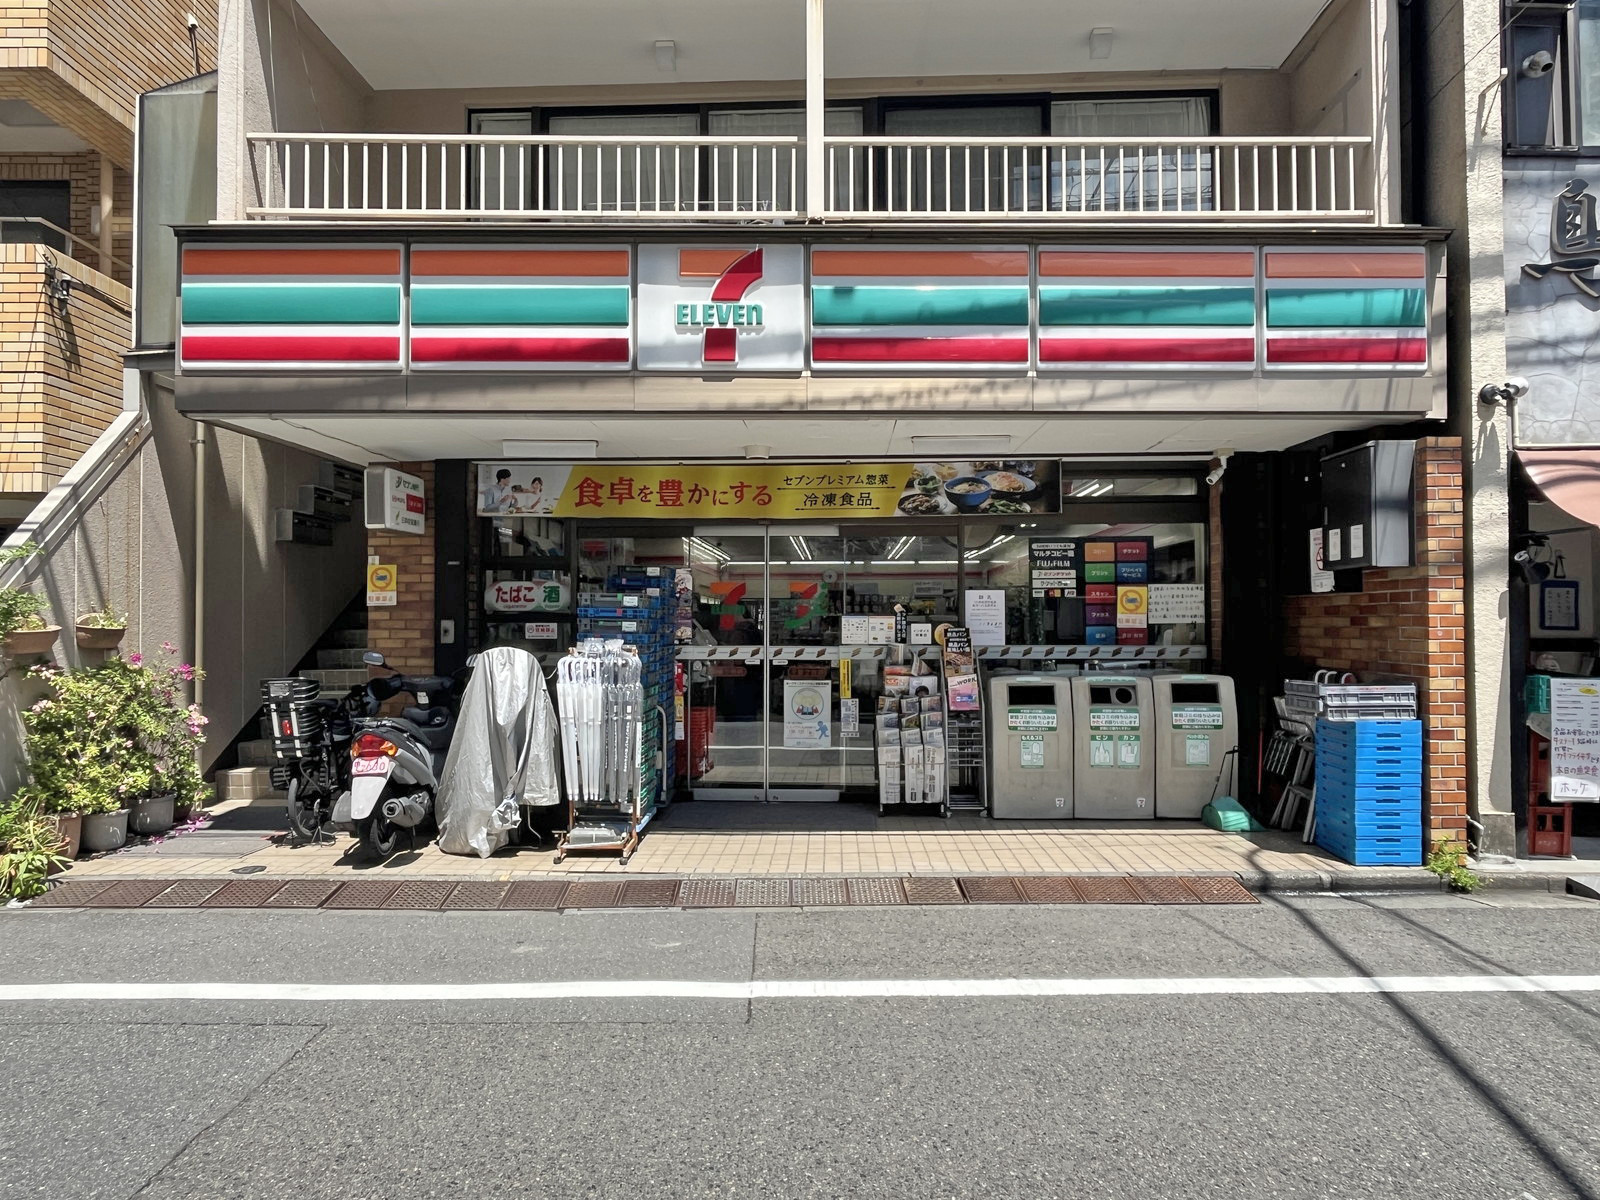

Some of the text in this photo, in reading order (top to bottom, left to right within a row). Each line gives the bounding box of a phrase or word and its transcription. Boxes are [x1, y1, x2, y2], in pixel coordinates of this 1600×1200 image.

[783, 474, 890, 486] セブンプレミアム惣菜
[573, 476, 772, 508] 食卓を豊かにする
[803, 492, 873, 507] 冷凍食品
[495, 585, 561, 603] たばこ 酒
[1559, 782, 1589, 796] ホッケ
